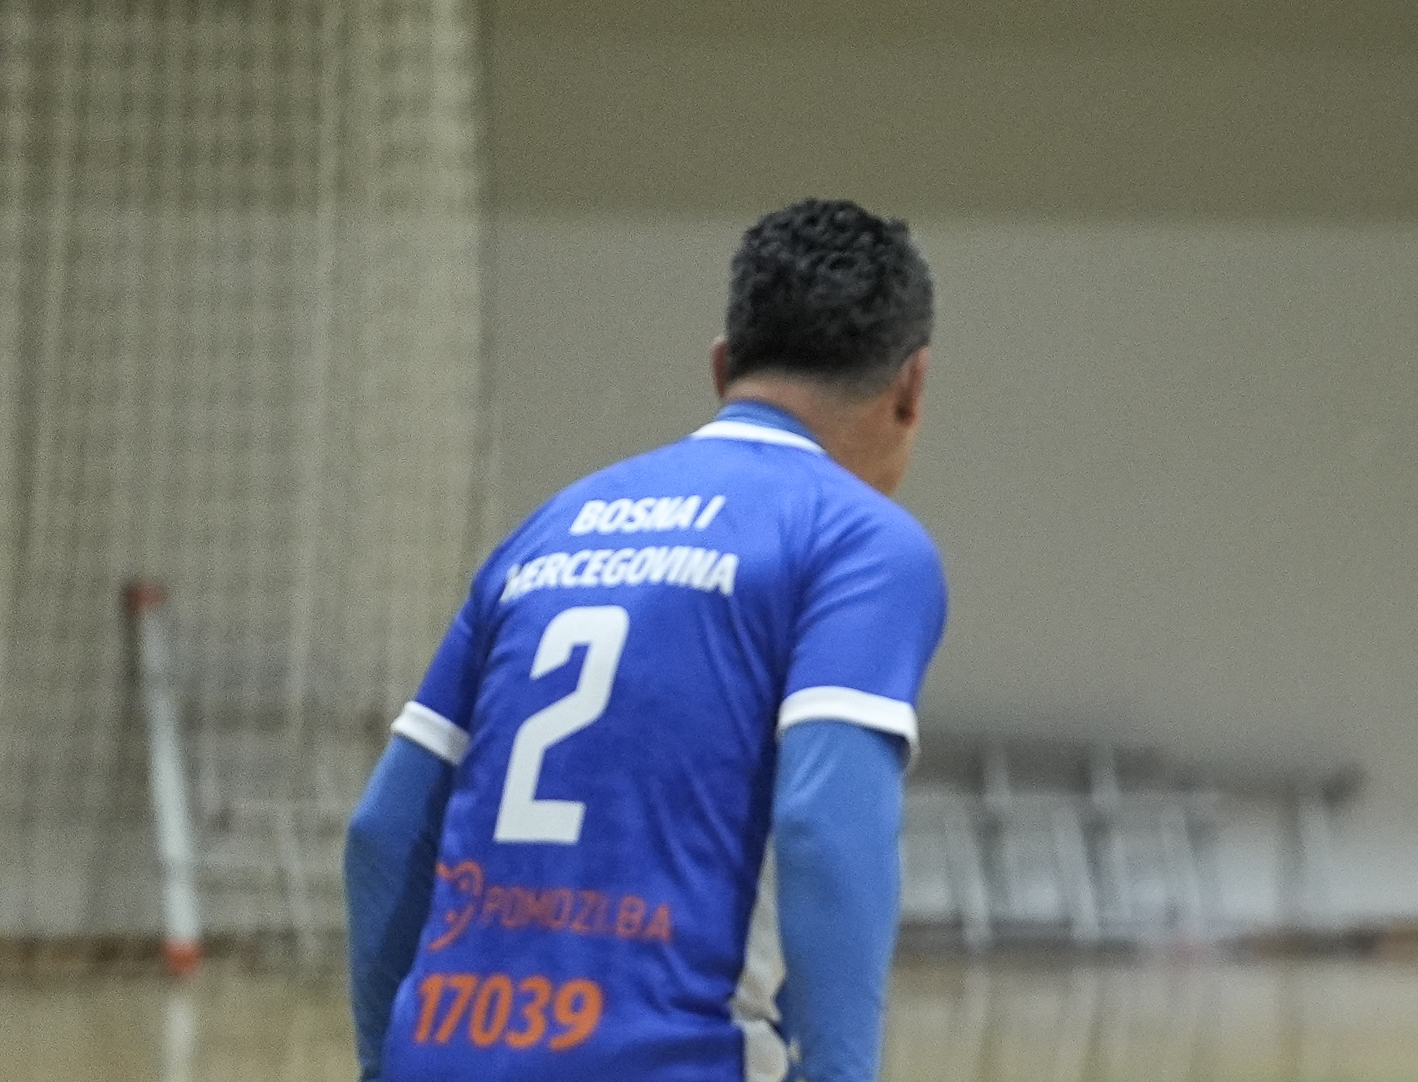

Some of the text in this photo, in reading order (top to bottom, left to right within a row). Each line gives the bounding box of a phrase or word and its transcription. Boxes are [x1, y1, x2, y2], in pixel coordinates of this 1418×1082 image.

[570, 495, 726, 535] BOSNA I
[499, 546, 739, 604] HERCEGOVINA
[494, 604, 630, 845] 2
[415, 972, 603, 1050] 17039
